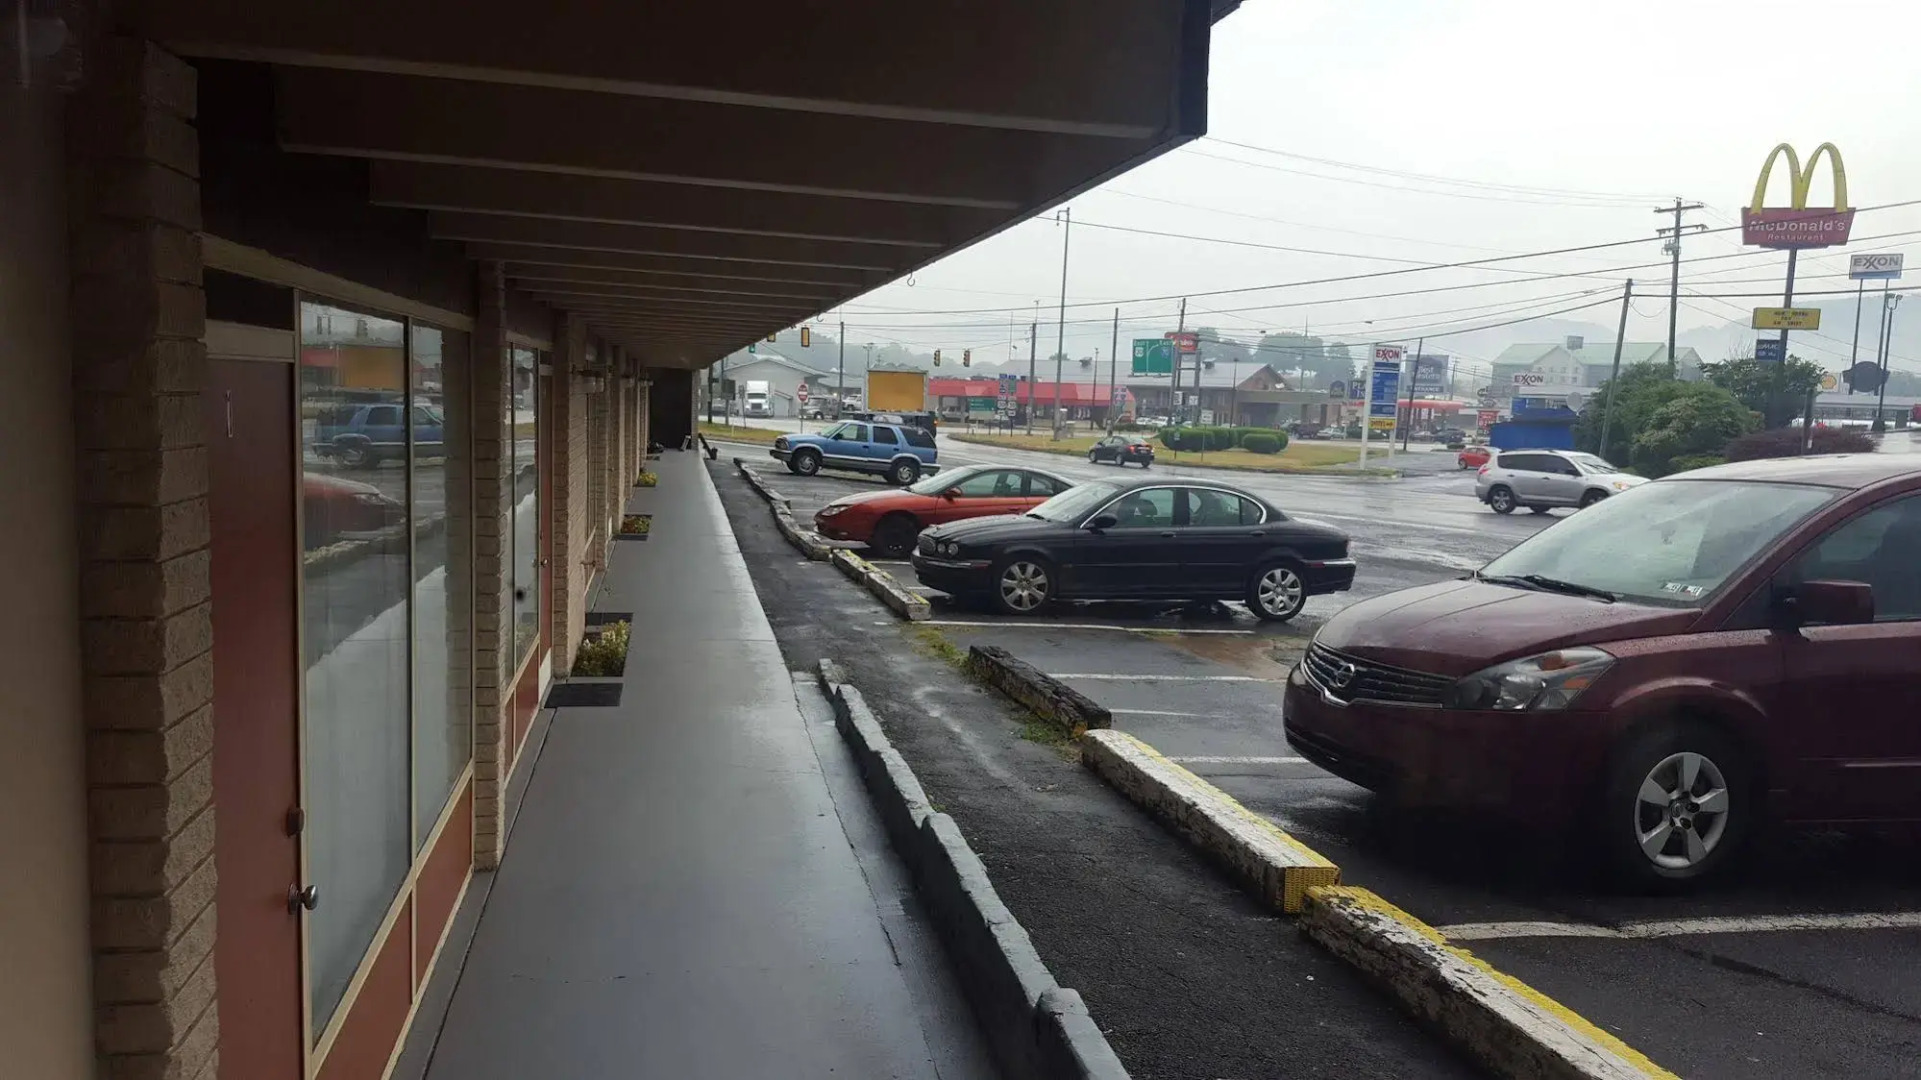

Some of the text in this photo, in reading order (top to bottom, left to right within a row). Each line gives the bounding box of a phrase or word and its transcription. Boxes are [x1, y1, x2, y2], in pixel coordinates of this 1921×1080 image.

[1749, 219, 1846, 232] McDonald's
[1853, 256, 1900, 270] EXXON
[1376, 348, 1400, 362] EXXON
[1418, 366, 1434, 374] Best
[1514, 374, 1544, 385] EXXON
